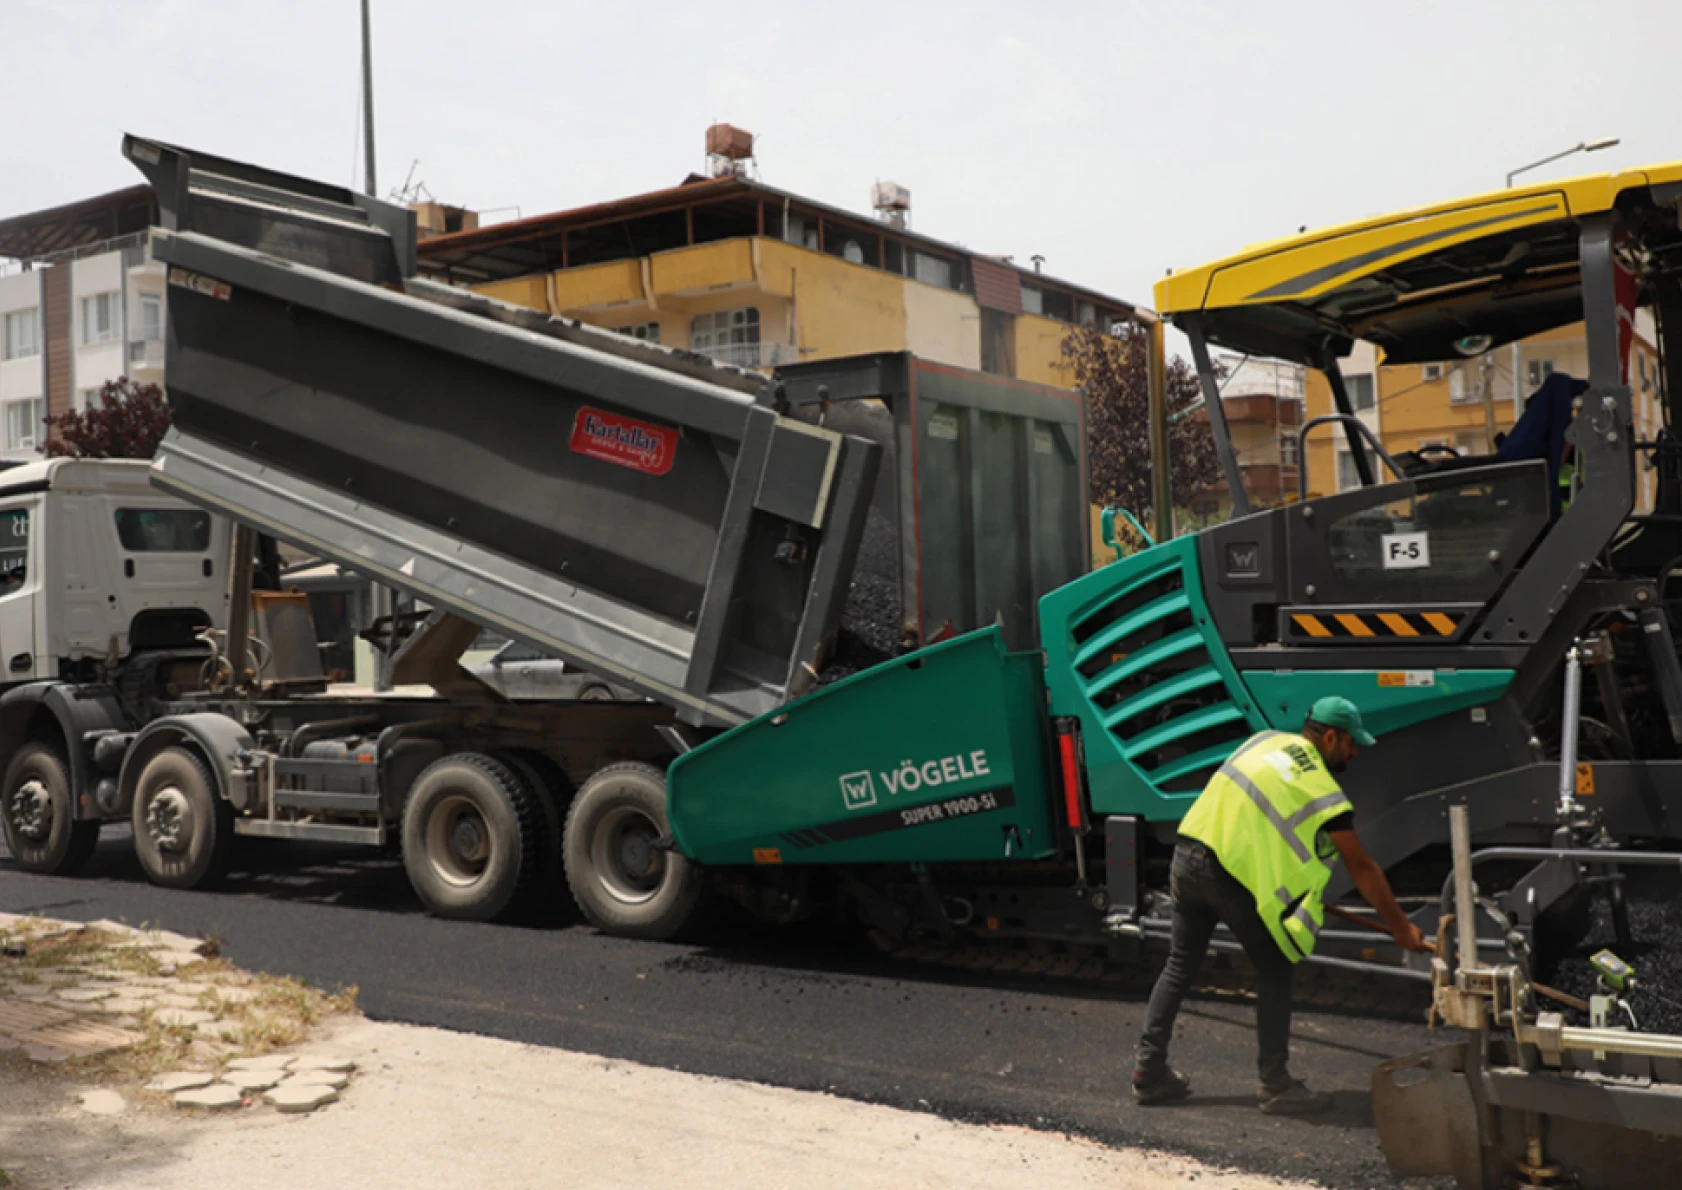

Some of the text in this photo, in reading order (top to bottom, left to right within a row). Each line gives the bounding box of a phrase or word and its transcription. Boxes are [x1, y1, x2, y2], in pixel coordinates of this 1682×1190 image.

[583, 413, 661, 452] Kartallar
[1389, 541, 1421, 560] F-5
[879, 749, 991, 795] VÖGELE
[900, 803, 944, 826] SUPER
